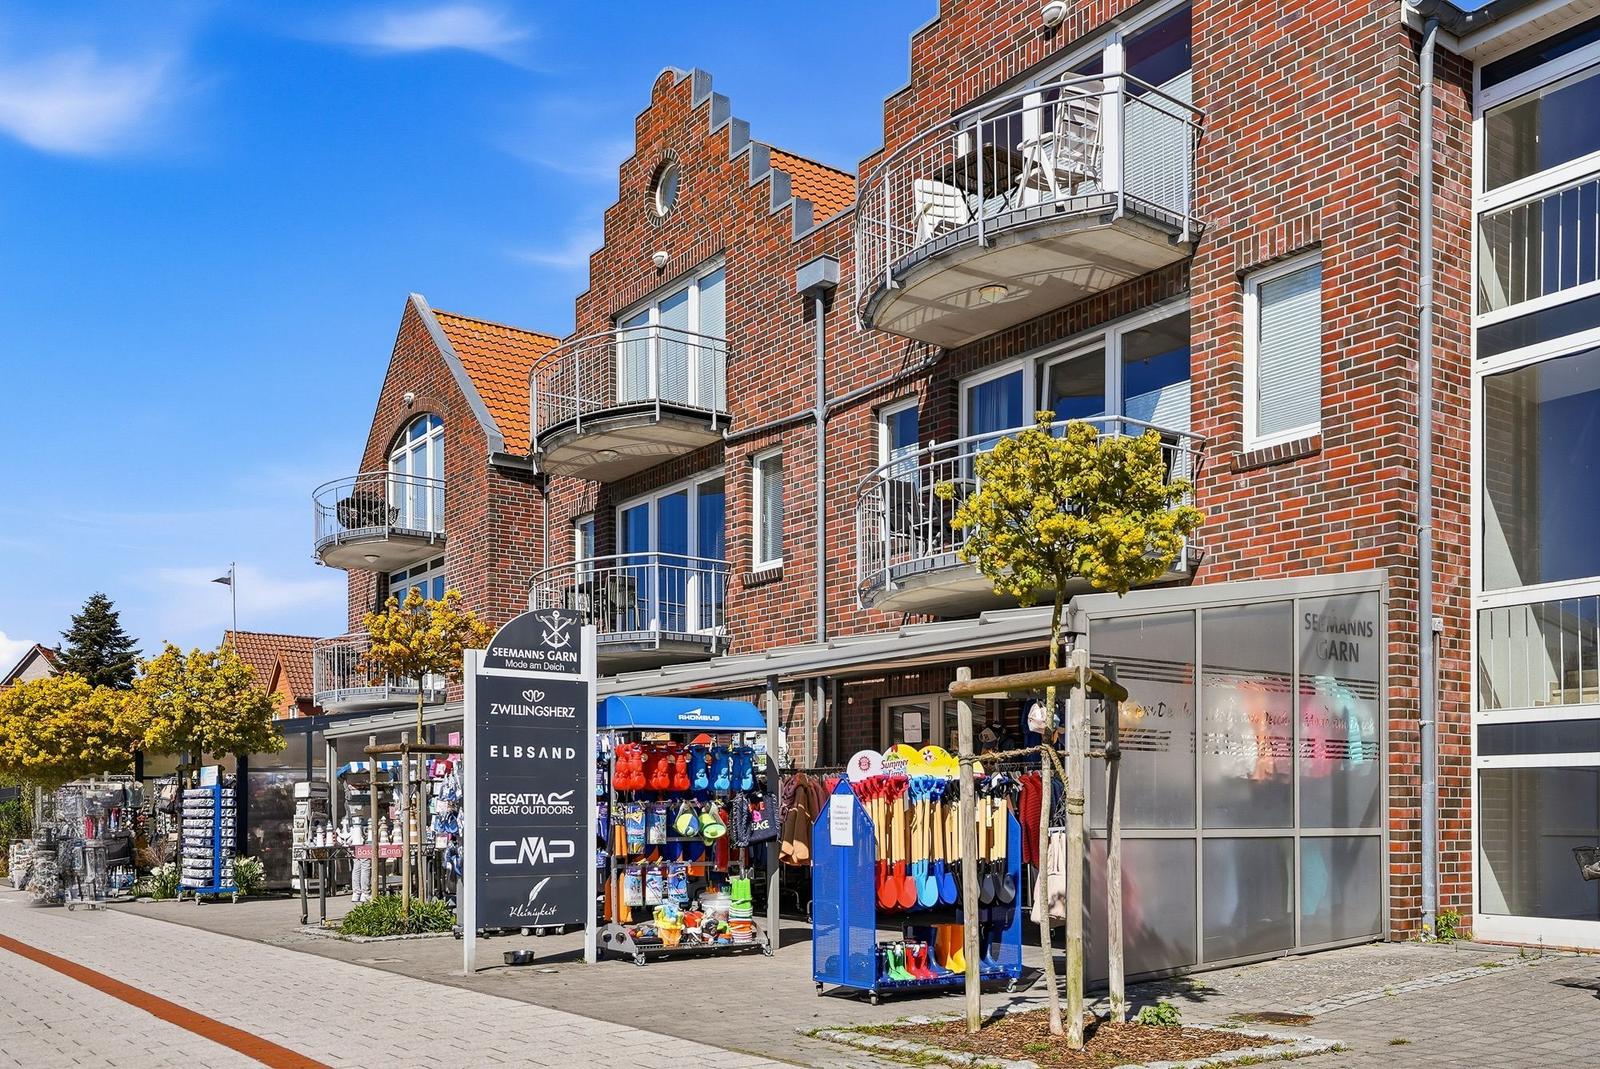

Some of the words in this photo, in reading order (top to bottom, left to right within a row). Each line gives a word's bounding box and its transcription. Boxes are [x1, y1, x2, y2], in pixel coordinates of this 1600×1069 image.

[492, 647, 544, 660] SEEMANNS
[548, 651, 577, 662] GARN
[505, 659, 528, 669] Mode
[530, 662, 542, 670] am
[544, 661, 564, 671] Deich
[490, 703, 575, 718] ZWILLINGSHERZ
[678, 714, 720, 722] RHOMBUS
[490, 745, 576, 760] ELBSAND
[881, 759, 909, 770] Summer
[490, 793, 546, 805] REGATTA
[490, 805, 519, 815] GREAT
[521, 805, 574, 815] OUTDOORS
[489, 836, 575, 866] CMP
[509, 903, 557, 925] Kleinigkeit
